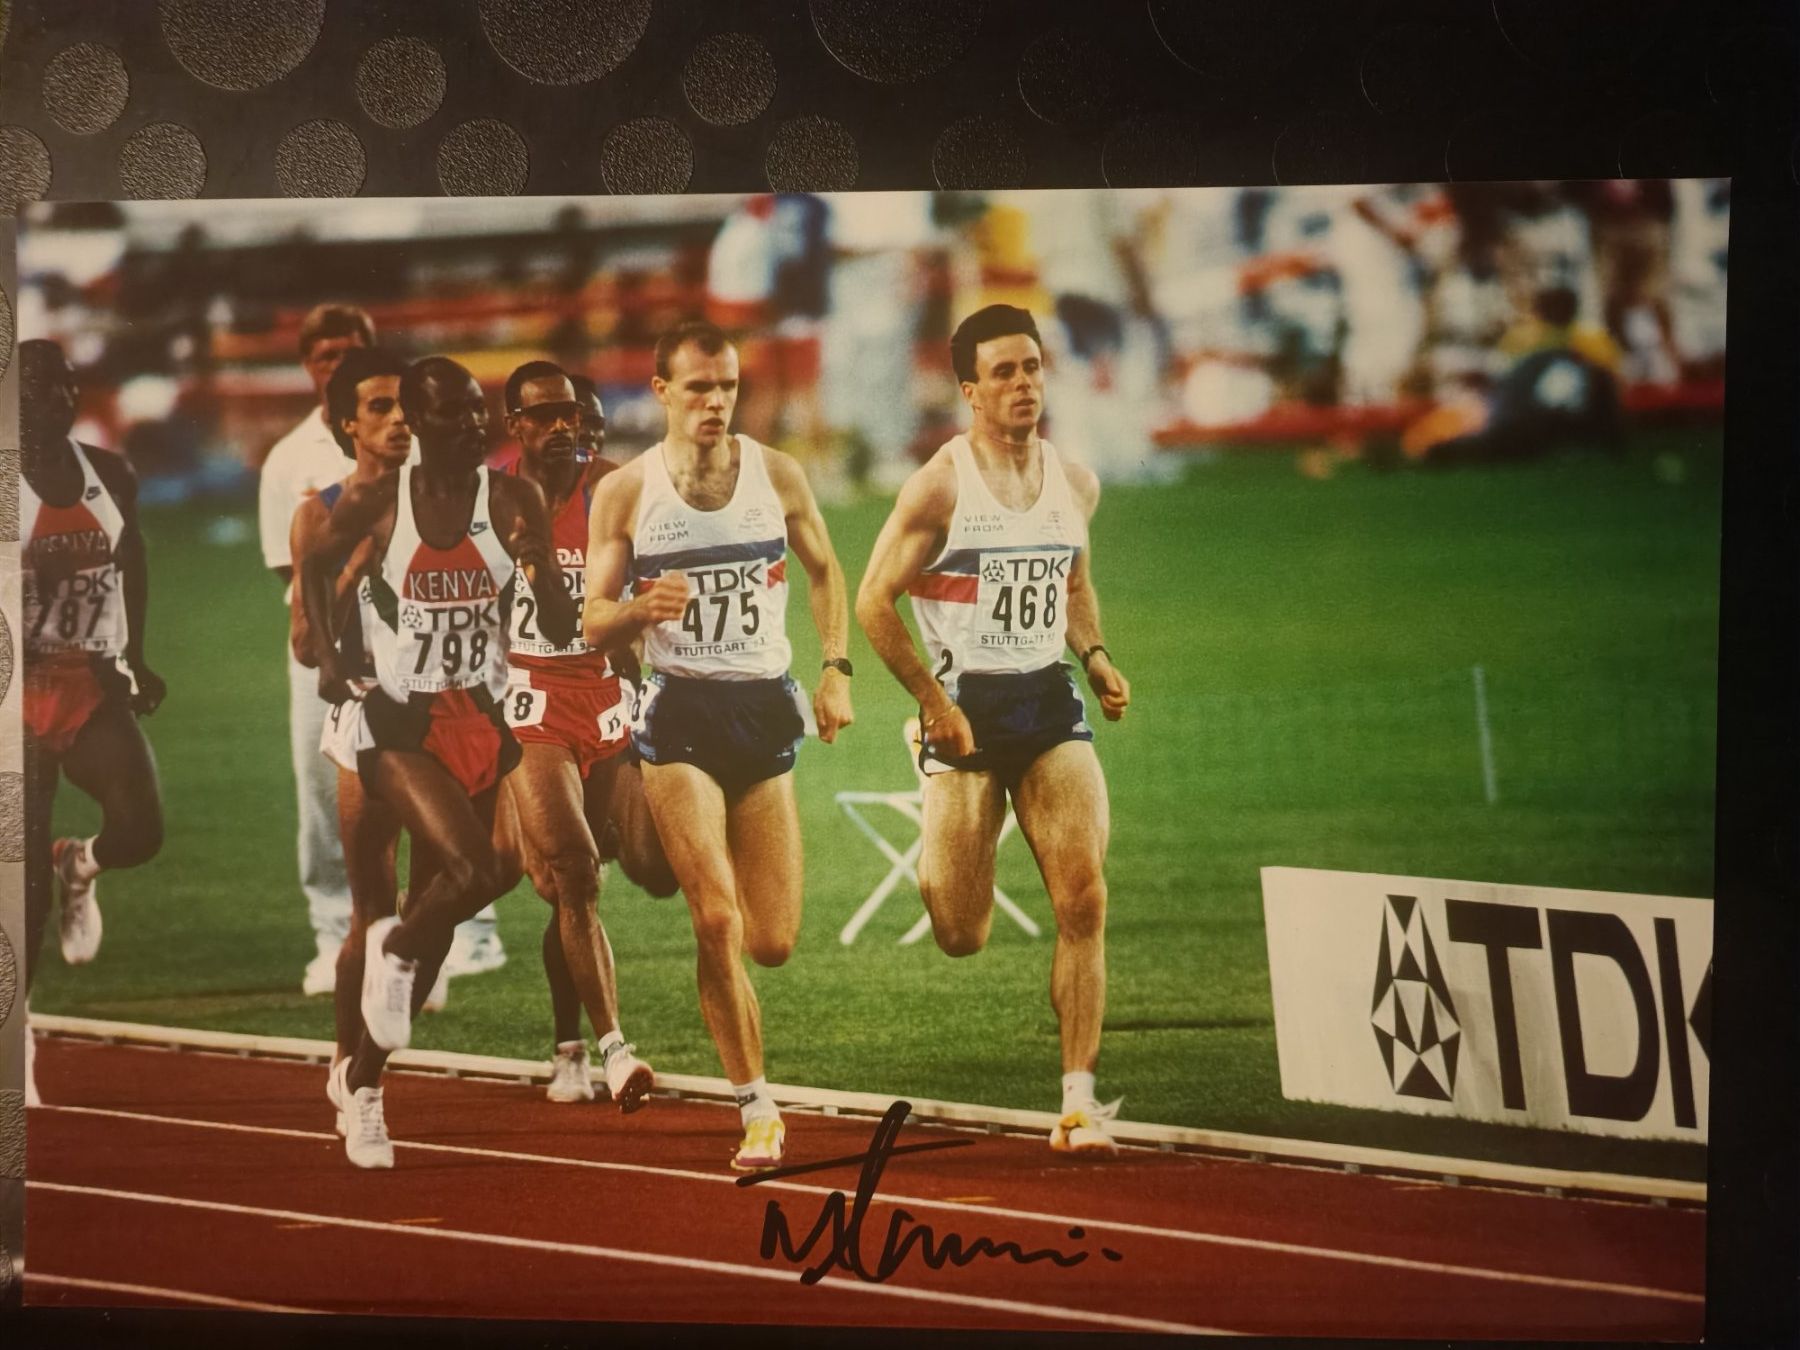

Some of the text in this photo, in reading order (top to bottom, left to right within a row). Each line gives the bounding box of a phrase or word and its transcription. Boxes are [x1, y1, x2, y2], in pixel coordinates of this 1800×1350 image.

[648, 520, 687, 532] VIEW
[650, 530, 690, 542] FROM
[556, 548, 586, 566] DA
[1007, 556, 1069, 582] TDK
[408, 568, 493, 600] KENYA
[687, 563, 763, 595] TDK
[423, 602, 499, 632] TDK
[682, 590, 760, 643] 475
[992, 583, 1058, 632] 468
[413, 629, 489, 676] 798
[674, 642, 746, 656] STUTTGART
[514, 691, 534, 721] 8
